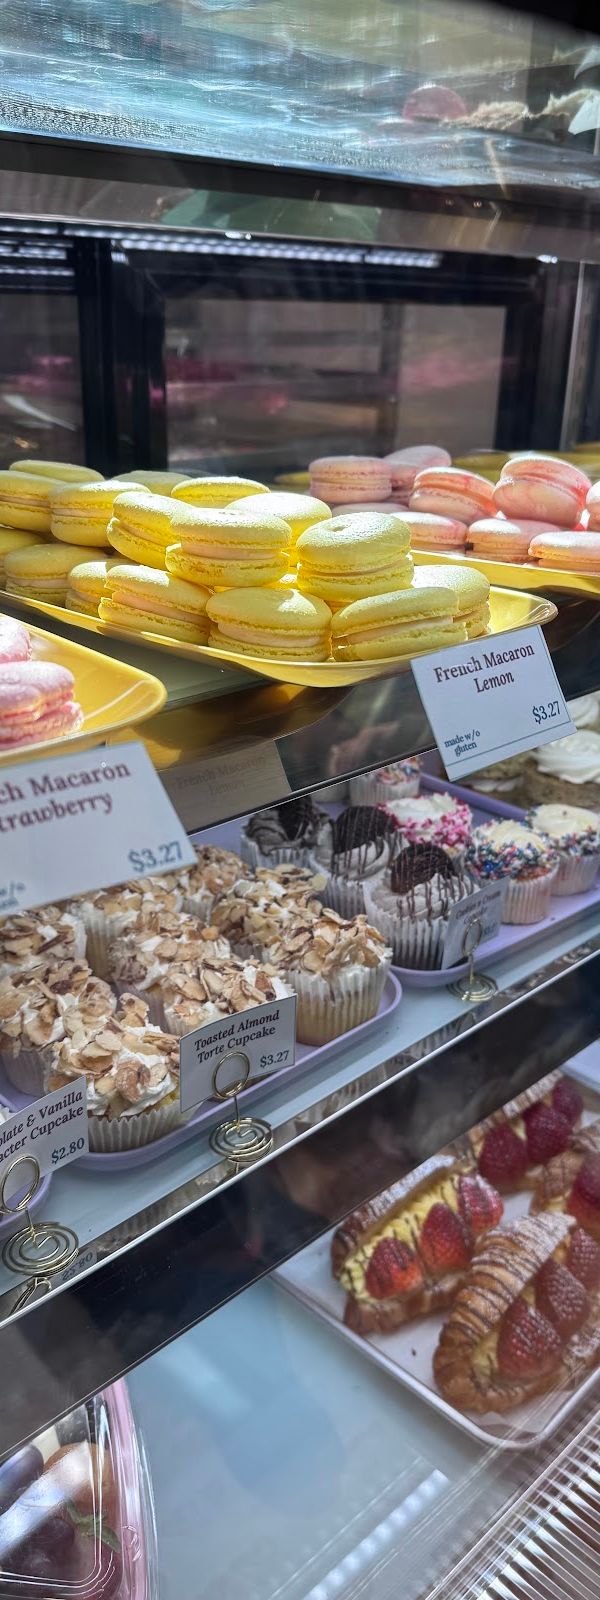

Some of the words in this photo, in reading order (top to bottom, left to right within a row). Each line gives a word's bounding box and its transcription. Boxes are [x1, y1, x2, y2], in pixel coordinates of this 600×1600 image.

[433, 656, 483, 683] French
[482, 644, 535, 667] Macaron
[473, 671, 515, 693] Lemon
[532, 701, 561, 725] $3.27
[444, 735, 465, 749] made
[464, 729, 481, 742] w/o
[453, 741, 478, 757] gluten
[28, 763, 131, 797] Macaron
[128, 841, 184, 873] $3.27
[194, 1025, 235, 1051] Toasted
[237, 1010, 280, 1033] Almond
[197, 1044, 225, 1064] Torte
[227, 1026, 276, 1049] Cupcake
[260, 1050, 290, 1069] $3.27
[26, 1113, 37, 1128] &
[38, 1091, 83, 1120] Vanilla
[30, 1106, 84, 1141] Cupcake
[51, 1137, 85, 1165] $2.80
